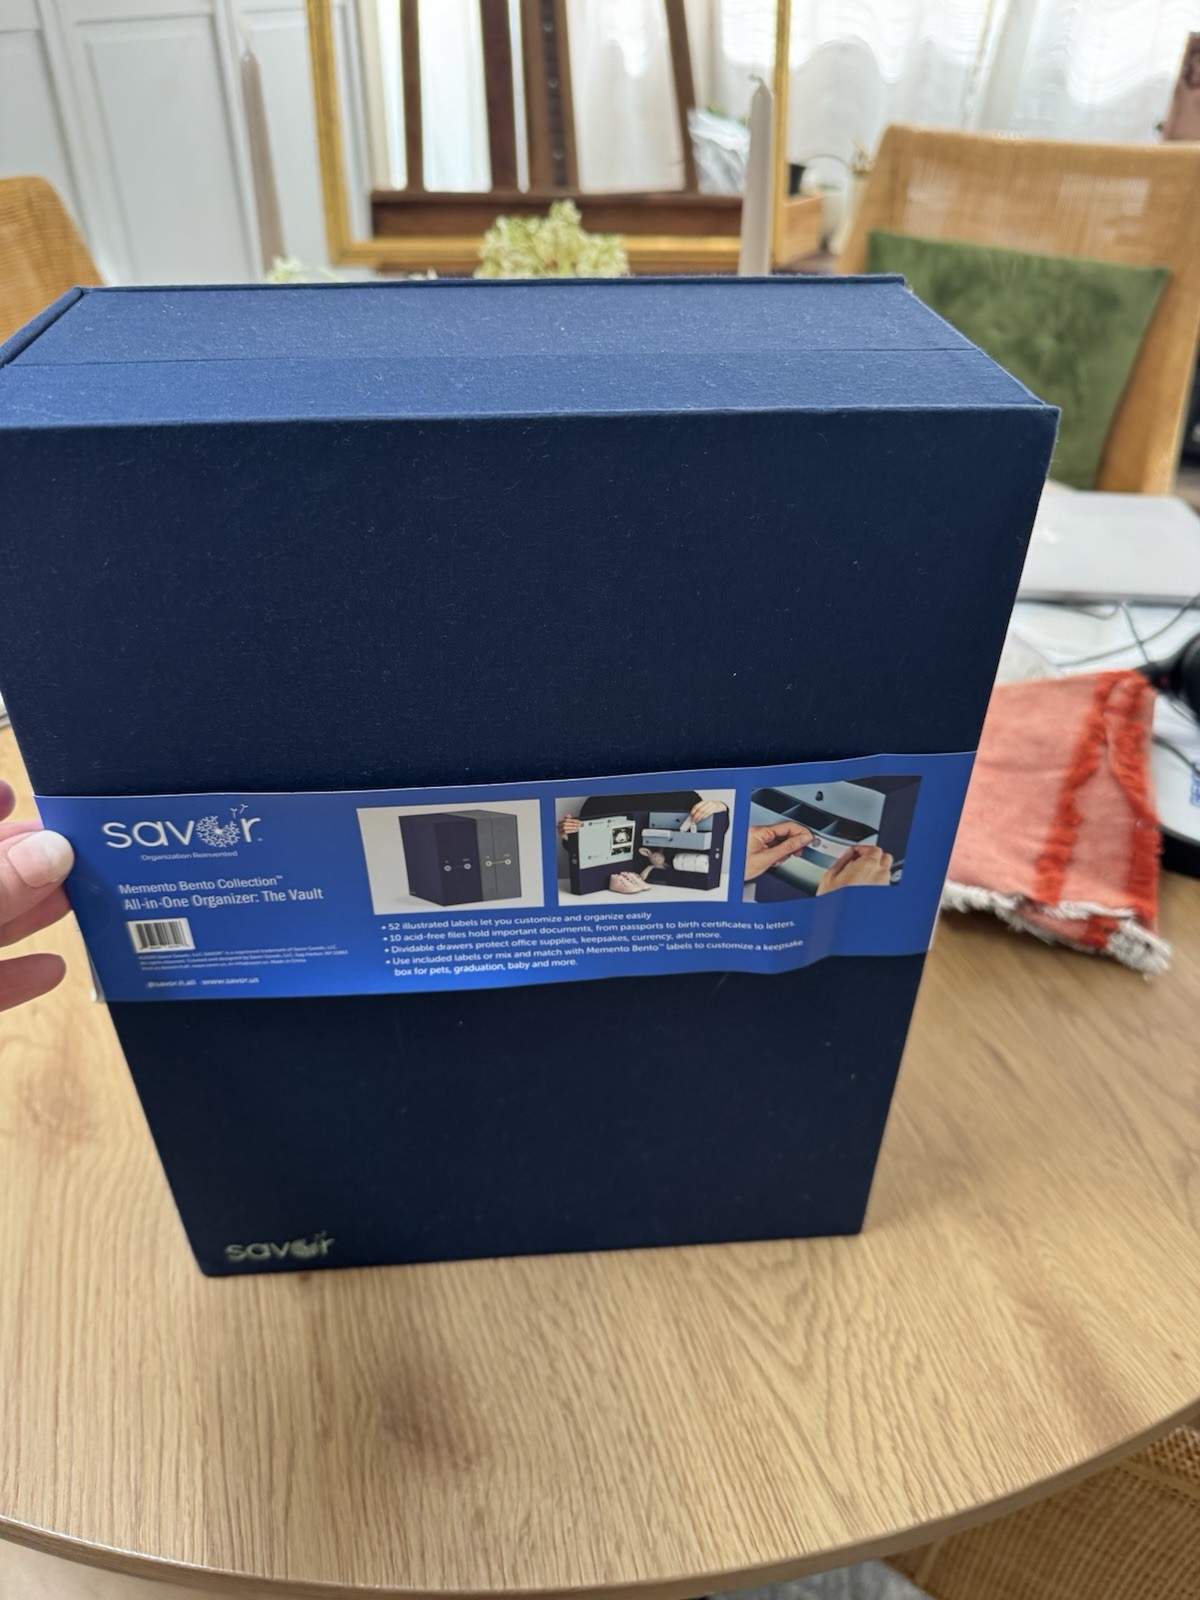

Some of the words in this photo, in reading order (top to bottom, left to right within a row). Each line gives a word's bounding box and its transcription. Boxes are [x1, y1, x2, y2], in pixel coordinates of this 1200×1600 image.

[102, 809, 261, 849] savor
[141, 852, 192, 862] Organization
[193, 850, 238, 859] Reinvented
[118, 883, 177, 895] Memento
[179, 880, 215, 892] Bento
[124, 896, 189, 911] All-in-One
[192, 893, 260, 908] Organizer:
[261, 890, 287, 902] The
[288, 887, 324, 901] Vault
[388, 922, 400, 931] 52
[402, 920, 449, 930] illustrated
[451, 918, 478, 928] labels
[480, 918, 492, 927] let
[494, 918, 512, 928] you
[514, 915, 562, 925] customize
[564, 914, 581, 923] and
[584, 912, 624, 922] organize
[626, 911, 652, 920] easily
[389, 934, 402, 943] 10
[403, 931, 446, 942] acid-free
[447, 930, 467, 940] files
[468, 929, 490, 938] hold
[491, 926, 538, 937] important
[540, 924, 594, 935] documents,
[596, 922, 618, 932] from
[620, 921, 664, 932] passports
[665, 921, 676, 929] to
[678, 919, 700, 929] birth
[701, 919, 752, 930] certificates
[753, 921, 764, 930] to
[391, 944, 435, 954] Dividable
[436, 942, 474, 952] drawers
[475, 940, 509, 950] protect
[511, 937, 538, 948] office
[539, 936, 579, 947] supplies,
[581, 934, 630, 945] keepsakes,
[631, 932, 674, 943] currency,
[675, 931, 694, 939] and
[695, 931, 721, 940] more.
[392, 957, 410, 966] Use
[412, 954, 453, 965] included
[454, 952, 481, 962] labels
[483, 952, 494, 961] or
[495, 950, 512, 960] mix
[513, 948, 532, 958] and
[533, 947, 563, 957] match
[564, 946, 585, 955] with
[586, 944, 630, 954] Memento
[666, 941, 692, 951] labels
[694, 941, 705, 950] to
[706, 940, 753, 950] customize
[755, 943, 762, 951] a
[762, 939, 804, 951] keepsake
[394, 967, 412, 976] box
[413, 966, 428, 976] for
[429, 964, 452, 976] pets,
[454, 962, 506, 975] graduation,
[507, 960, 530, 971] baby
[531, 959, 549, 968] and
[551, 958, 578, 968] more.
[225, 1233, 335, 1260] savor
